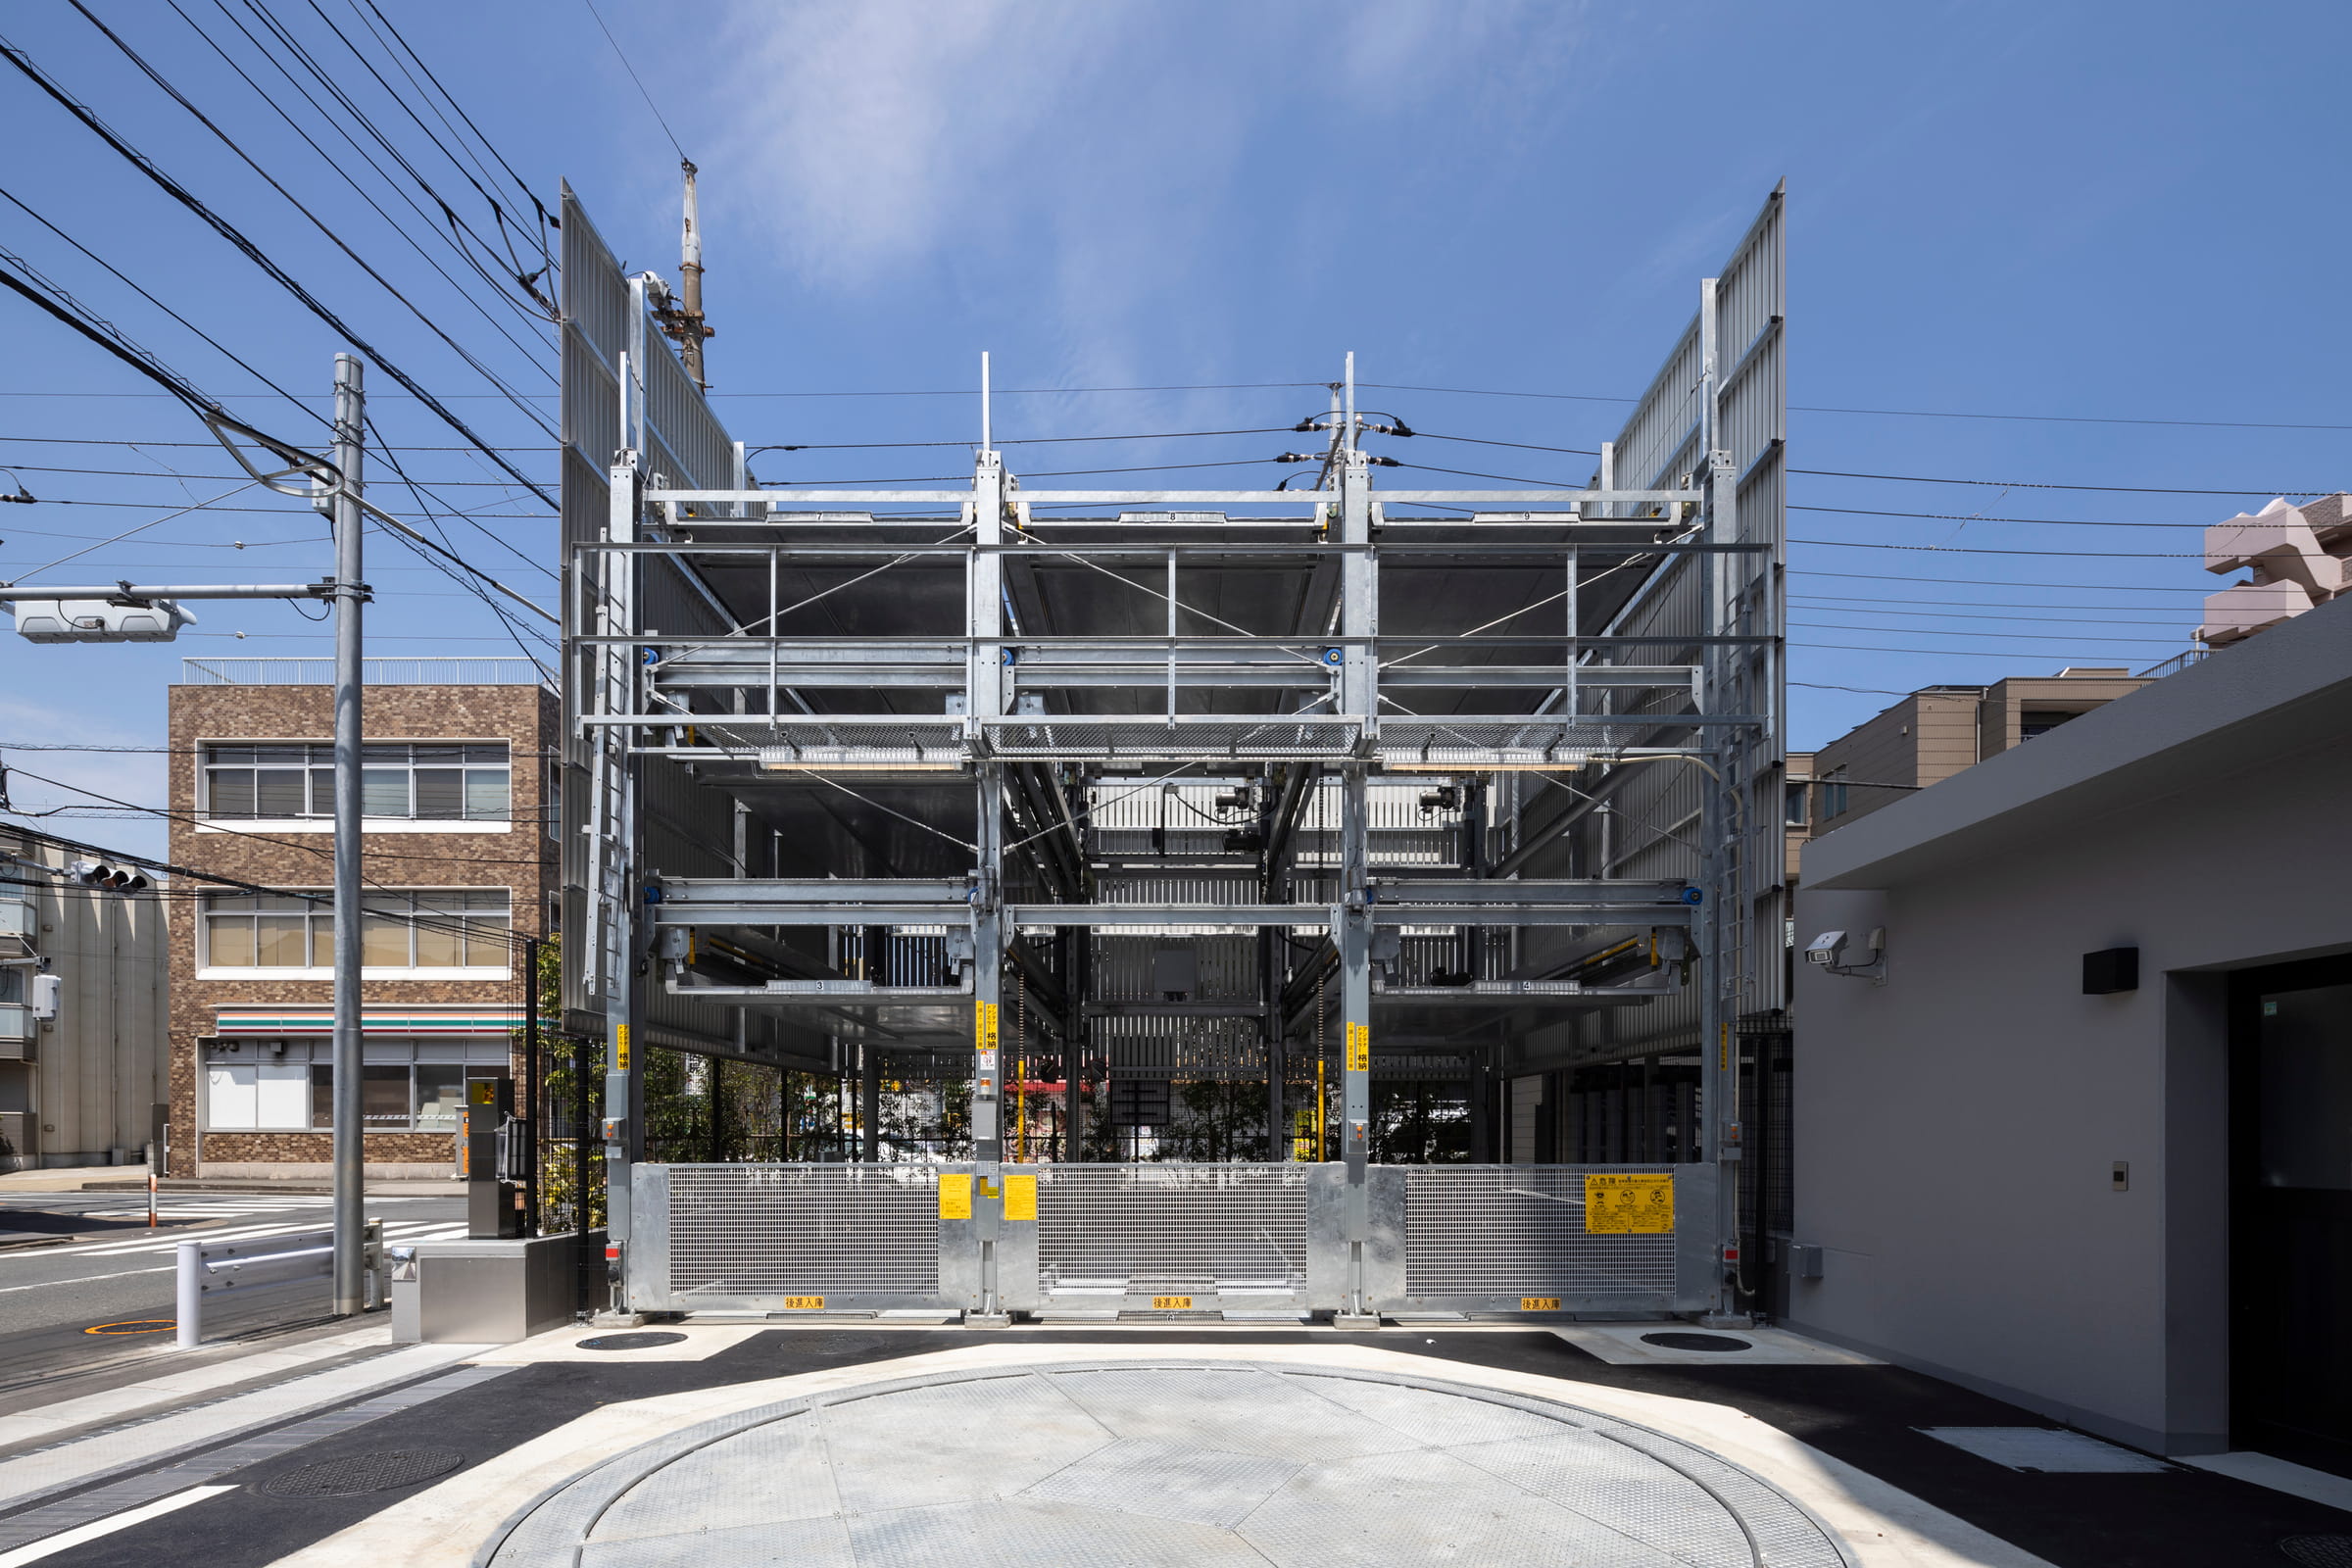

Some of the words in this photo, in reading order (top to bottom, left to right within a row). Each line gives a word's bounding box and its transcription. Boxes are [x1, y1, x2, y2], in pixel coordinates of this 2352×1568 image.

[816, 512, 823, 520] 7
[1169, 512, 1176, 520] 8
[1524, 512, 1530, 520] 9
[816, 981, 823, 990] 3
[785, 1297, 823, 1308] 後進入庫
[1153, 1297, 1192, 1308] 後進入庫
[1522, 1298, 1560, 1309] 後進入庫
